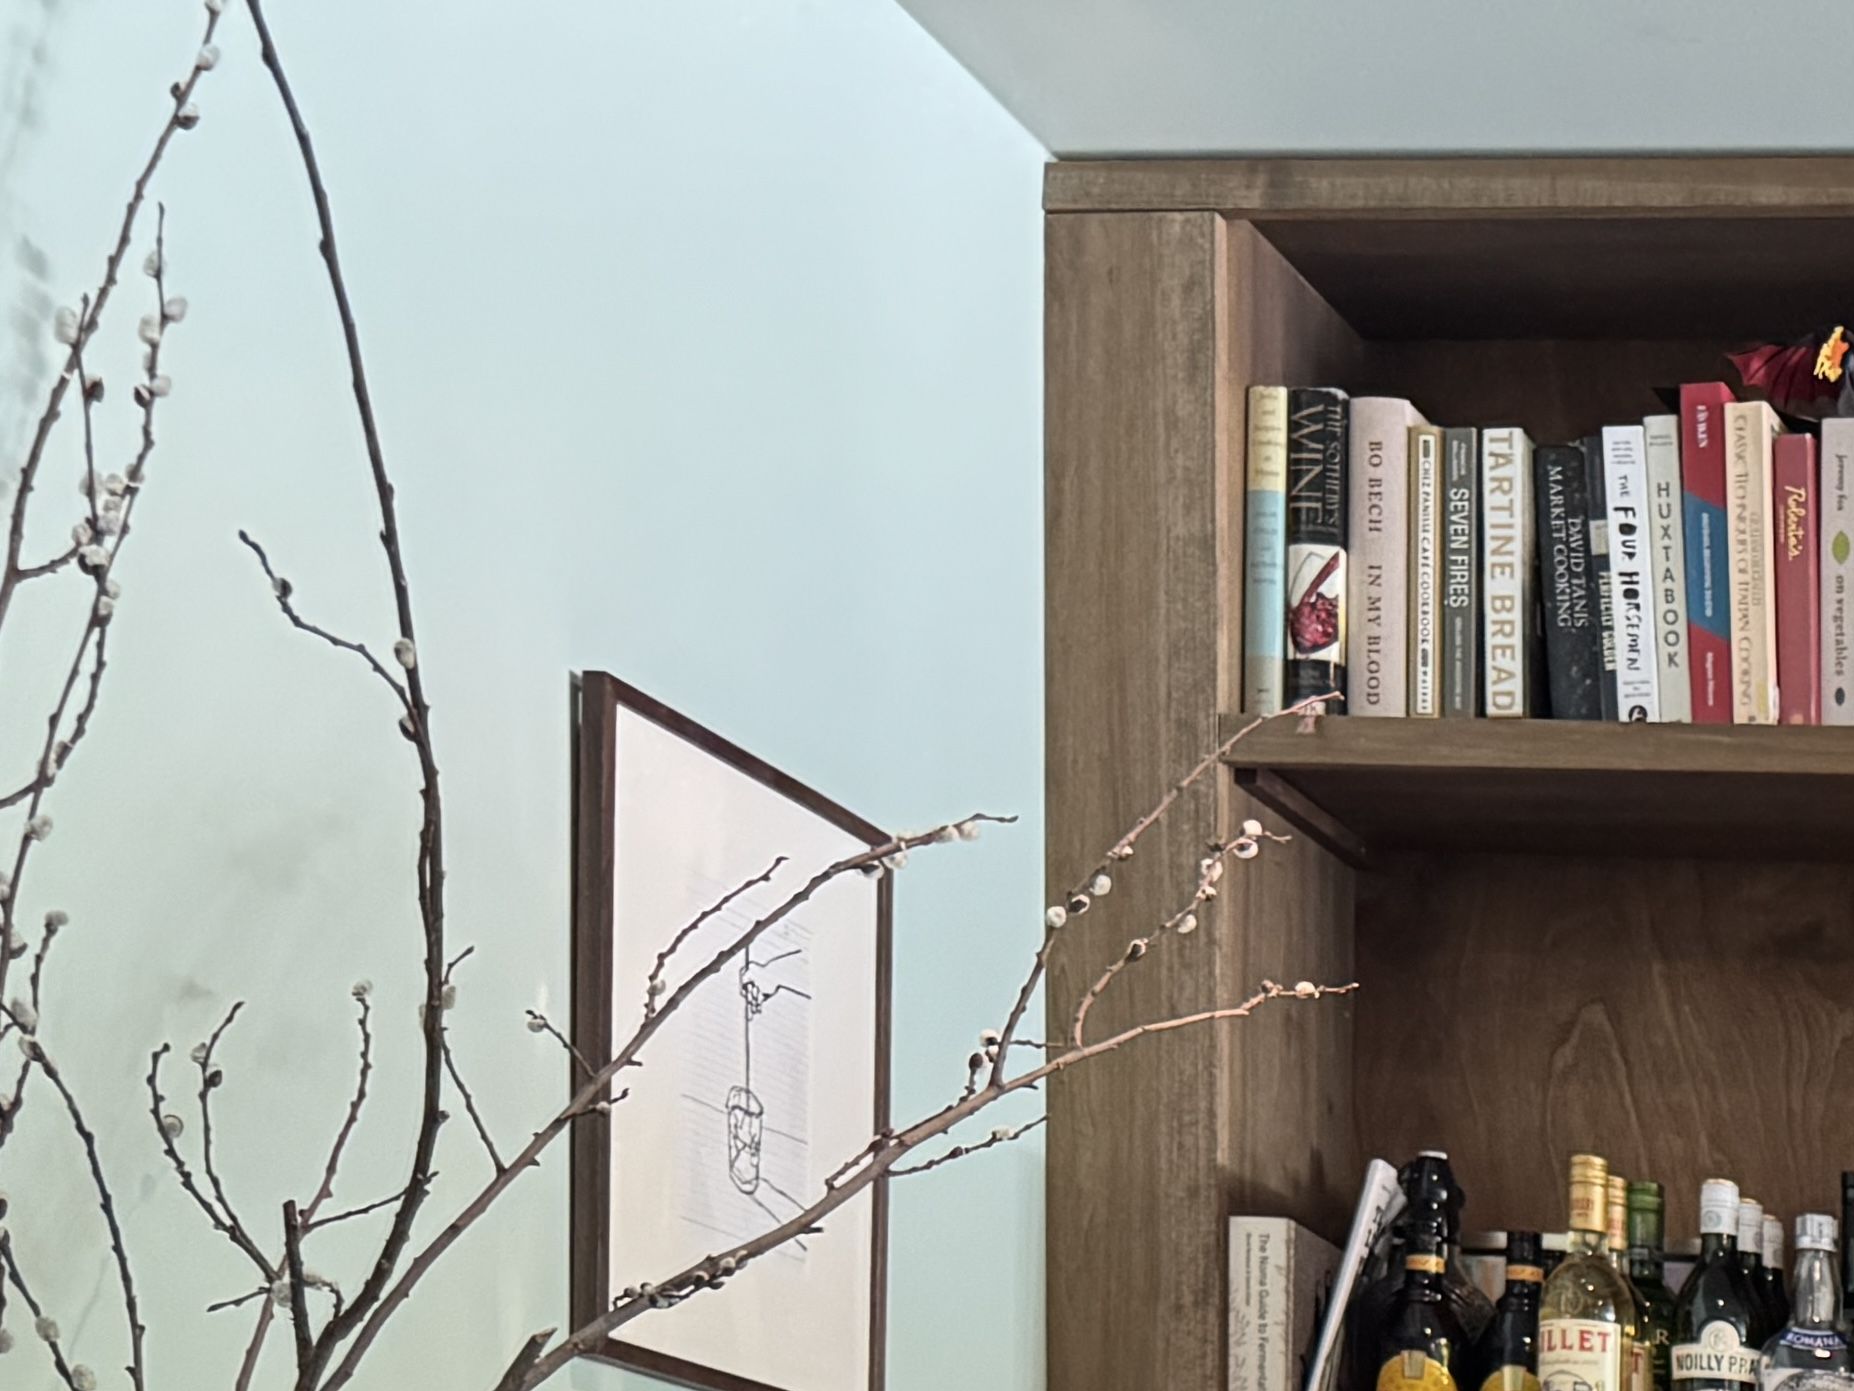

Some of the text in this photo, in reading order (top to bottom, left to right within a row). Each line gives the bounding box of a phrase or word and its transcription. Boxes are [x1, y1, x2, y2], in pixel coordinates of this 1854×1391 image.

[1290, 404, 1323, 523] WINE
[1369, 441, 1382, 533] BO BECH
[1449, 488, 1469, 551] SEVEN
[1548, 465, 1571, 628] MARKET COOKING
[1784, 486, 1806, 561] Roberta's
[1449, 555, 1468, 608] FIRES
[1490, 432, 1515, 711] TARTINE BREAD
[1567, 518, 1588, 628] DAVID TANIS
[1656, 482, 1680, 668] HUXTABOOK
[1367, 565, 1382, 705] IN MY BLOOD
[1618, 571, 1642, 671] HORSEMEN
[1833, 575, 1850, 677] on vegetables
[1739, 636, 1753, 706] COOKING
[1258, 1256, 1268, 1287] Noma
[1259, 1233, 1270, 1252] The
[1258, 1290, 1269, 1320] Guide
[1258, 1322, 1268, 1335] to
[1539, 1330, 1613, 1352] ILLET
[1786, 1332, 1841, 1347] ROMANA
[1676, 1355, 1725, 1372] NOILLY
